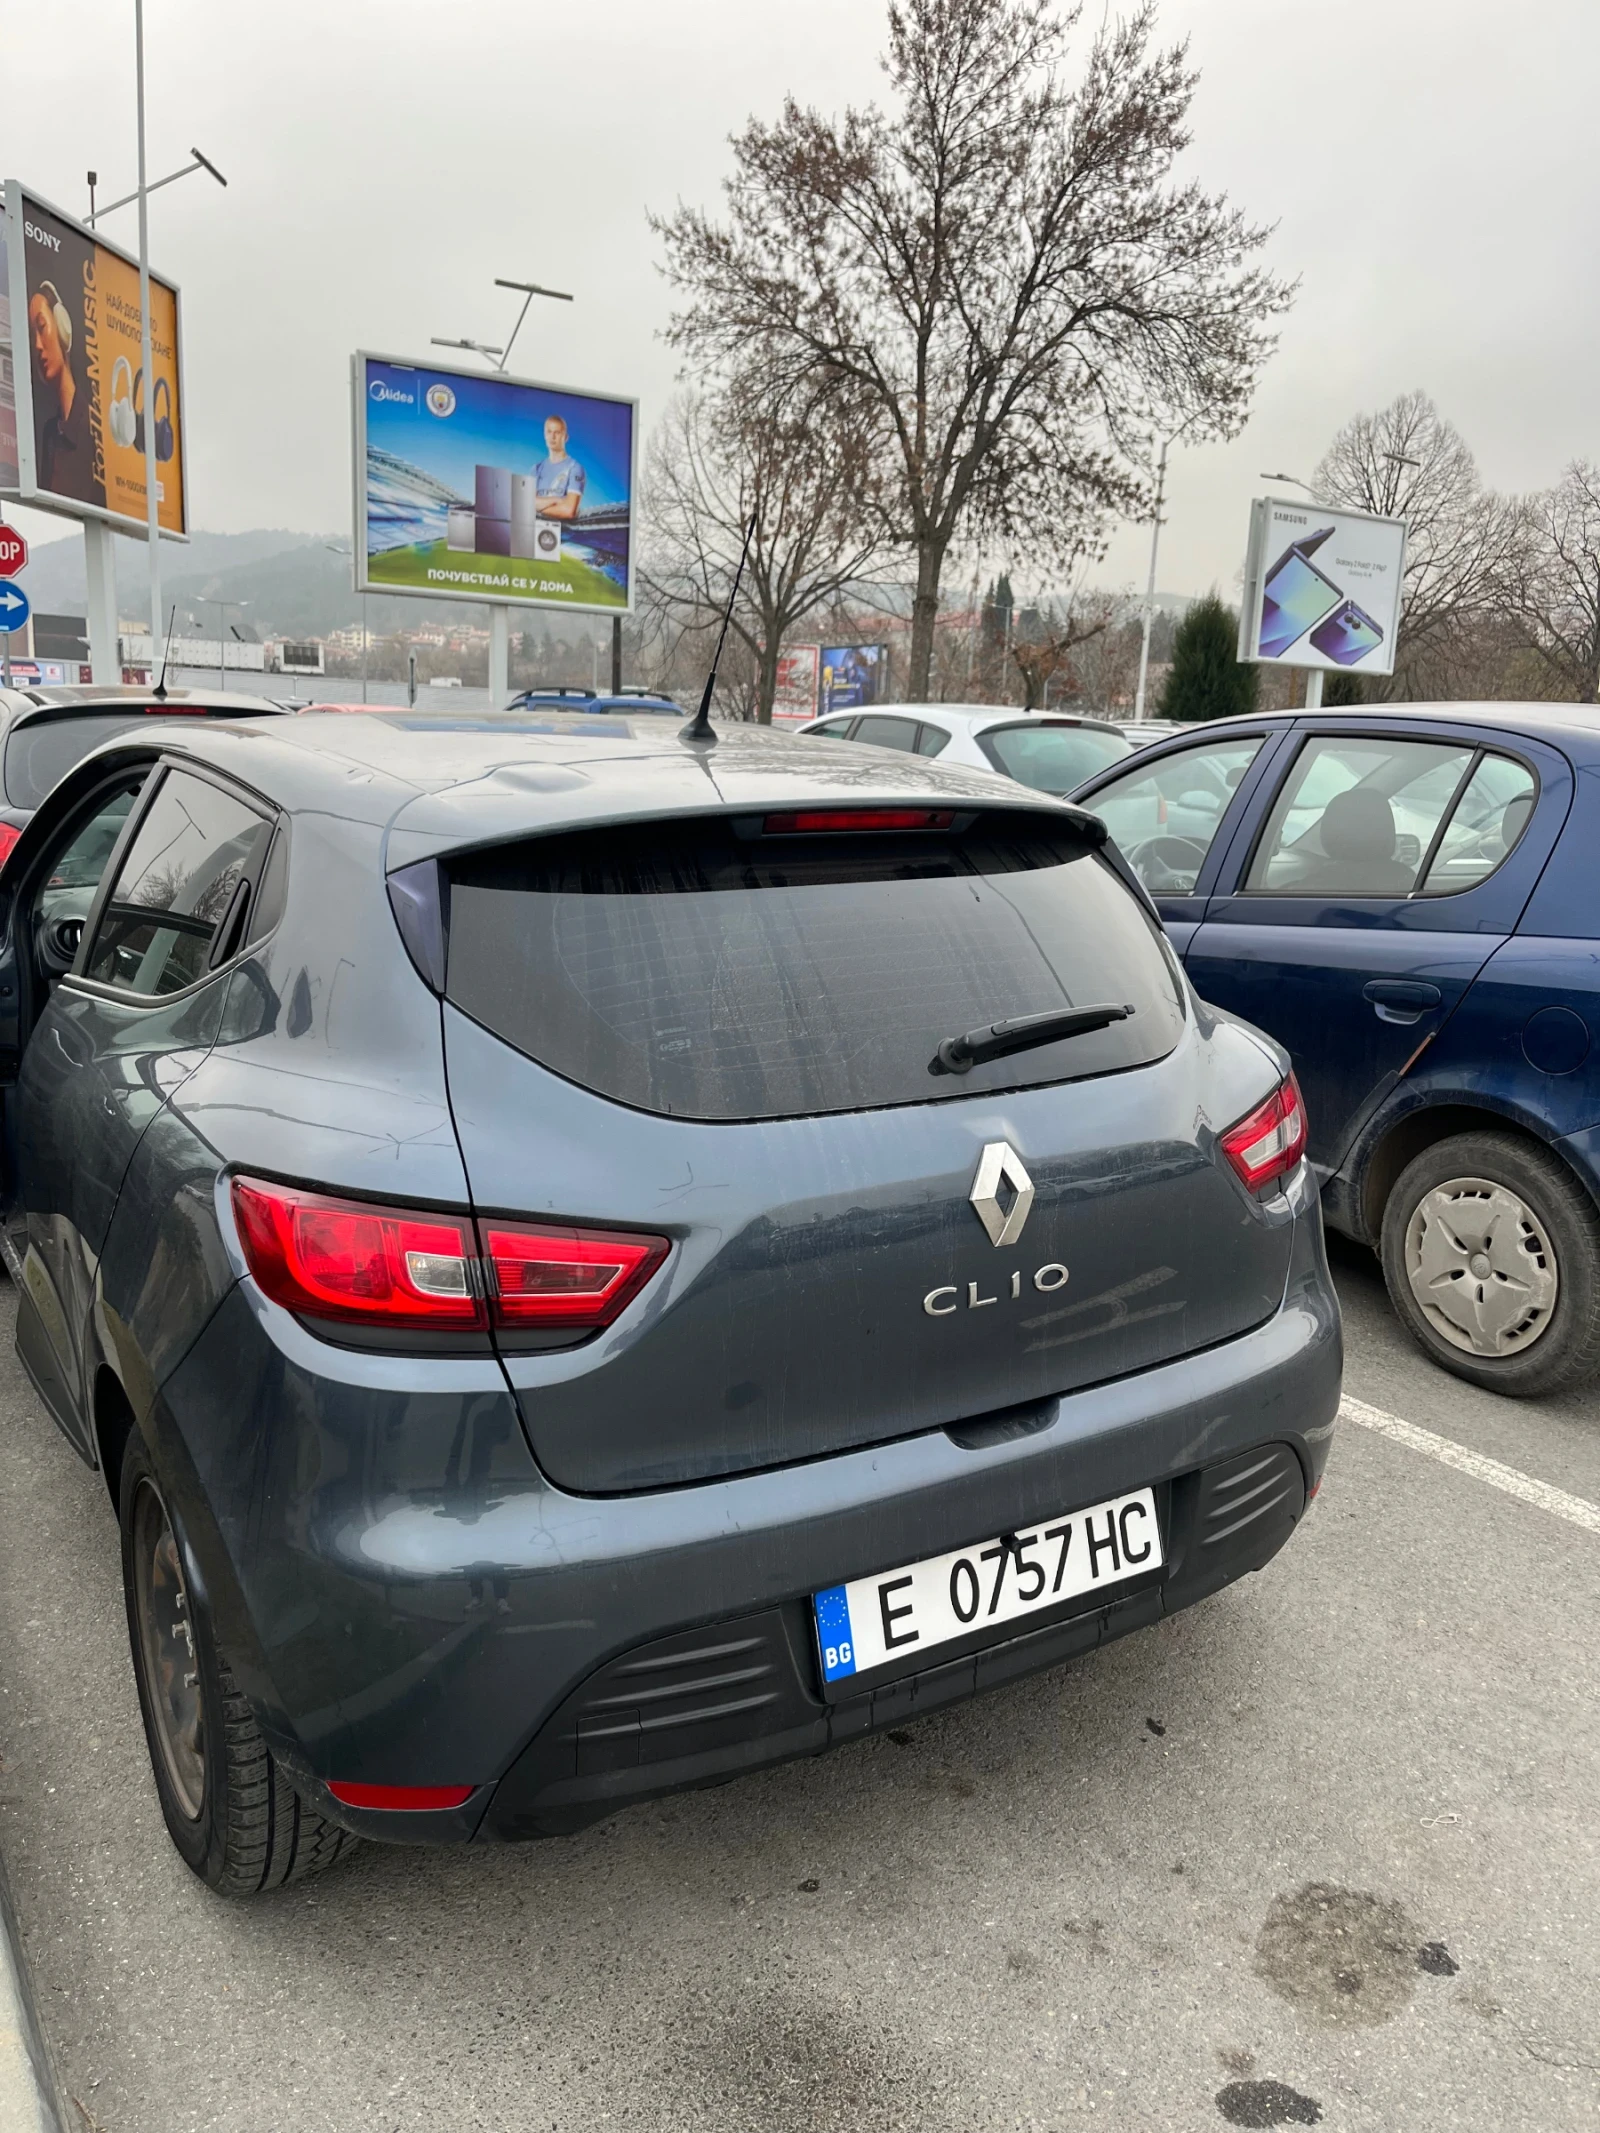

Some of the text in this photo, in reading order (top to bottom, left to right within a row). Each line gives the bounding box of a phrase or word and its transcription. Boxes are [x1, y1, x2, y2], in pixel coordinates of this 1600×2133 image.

[24, 221, 61, 252] SONY
[370, 383, 414, 404] Midea
[1273, 511, 1307, 525] SAMSUNG
[0, 541, 20, 560] OP
[427, 568, 574, 594] ПОЧУВСТВАЙ СЕ У ДОМА
[923, 1263, 1070, 1316] CLIO
[878, 1501, 1151, 1650] E 0757 HC
[825, 1642, 851, 1669] BG
